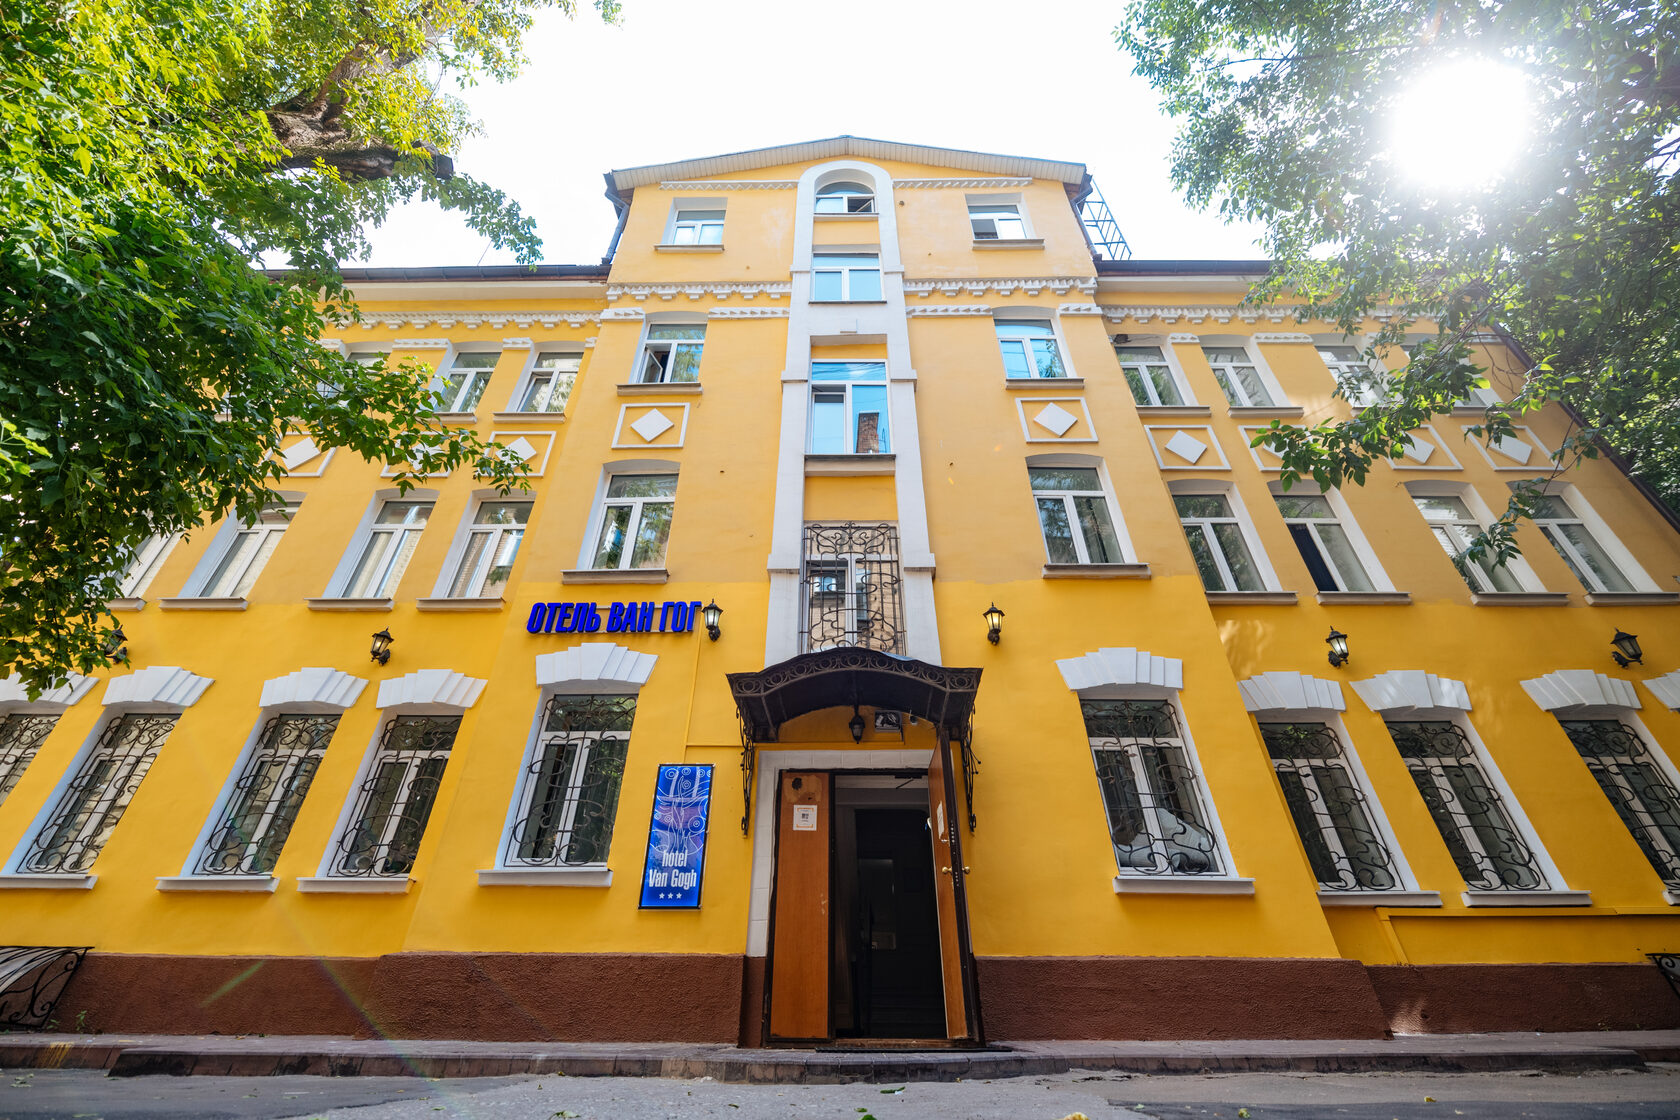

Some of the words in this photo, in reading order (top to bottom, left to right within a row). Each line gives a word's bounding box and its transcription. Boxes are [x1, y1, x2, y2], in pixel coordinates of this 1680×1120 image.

[526, 602, 602, 634] ОТЕЛЬ
[606, 601, 655, 633] ВАН
[659, 601, 702, 632] ГОГ
[662, 849, 688, 867] hotel
[648, 869, 668, 888] Van
[670, 869, 697, 890] Gogh
